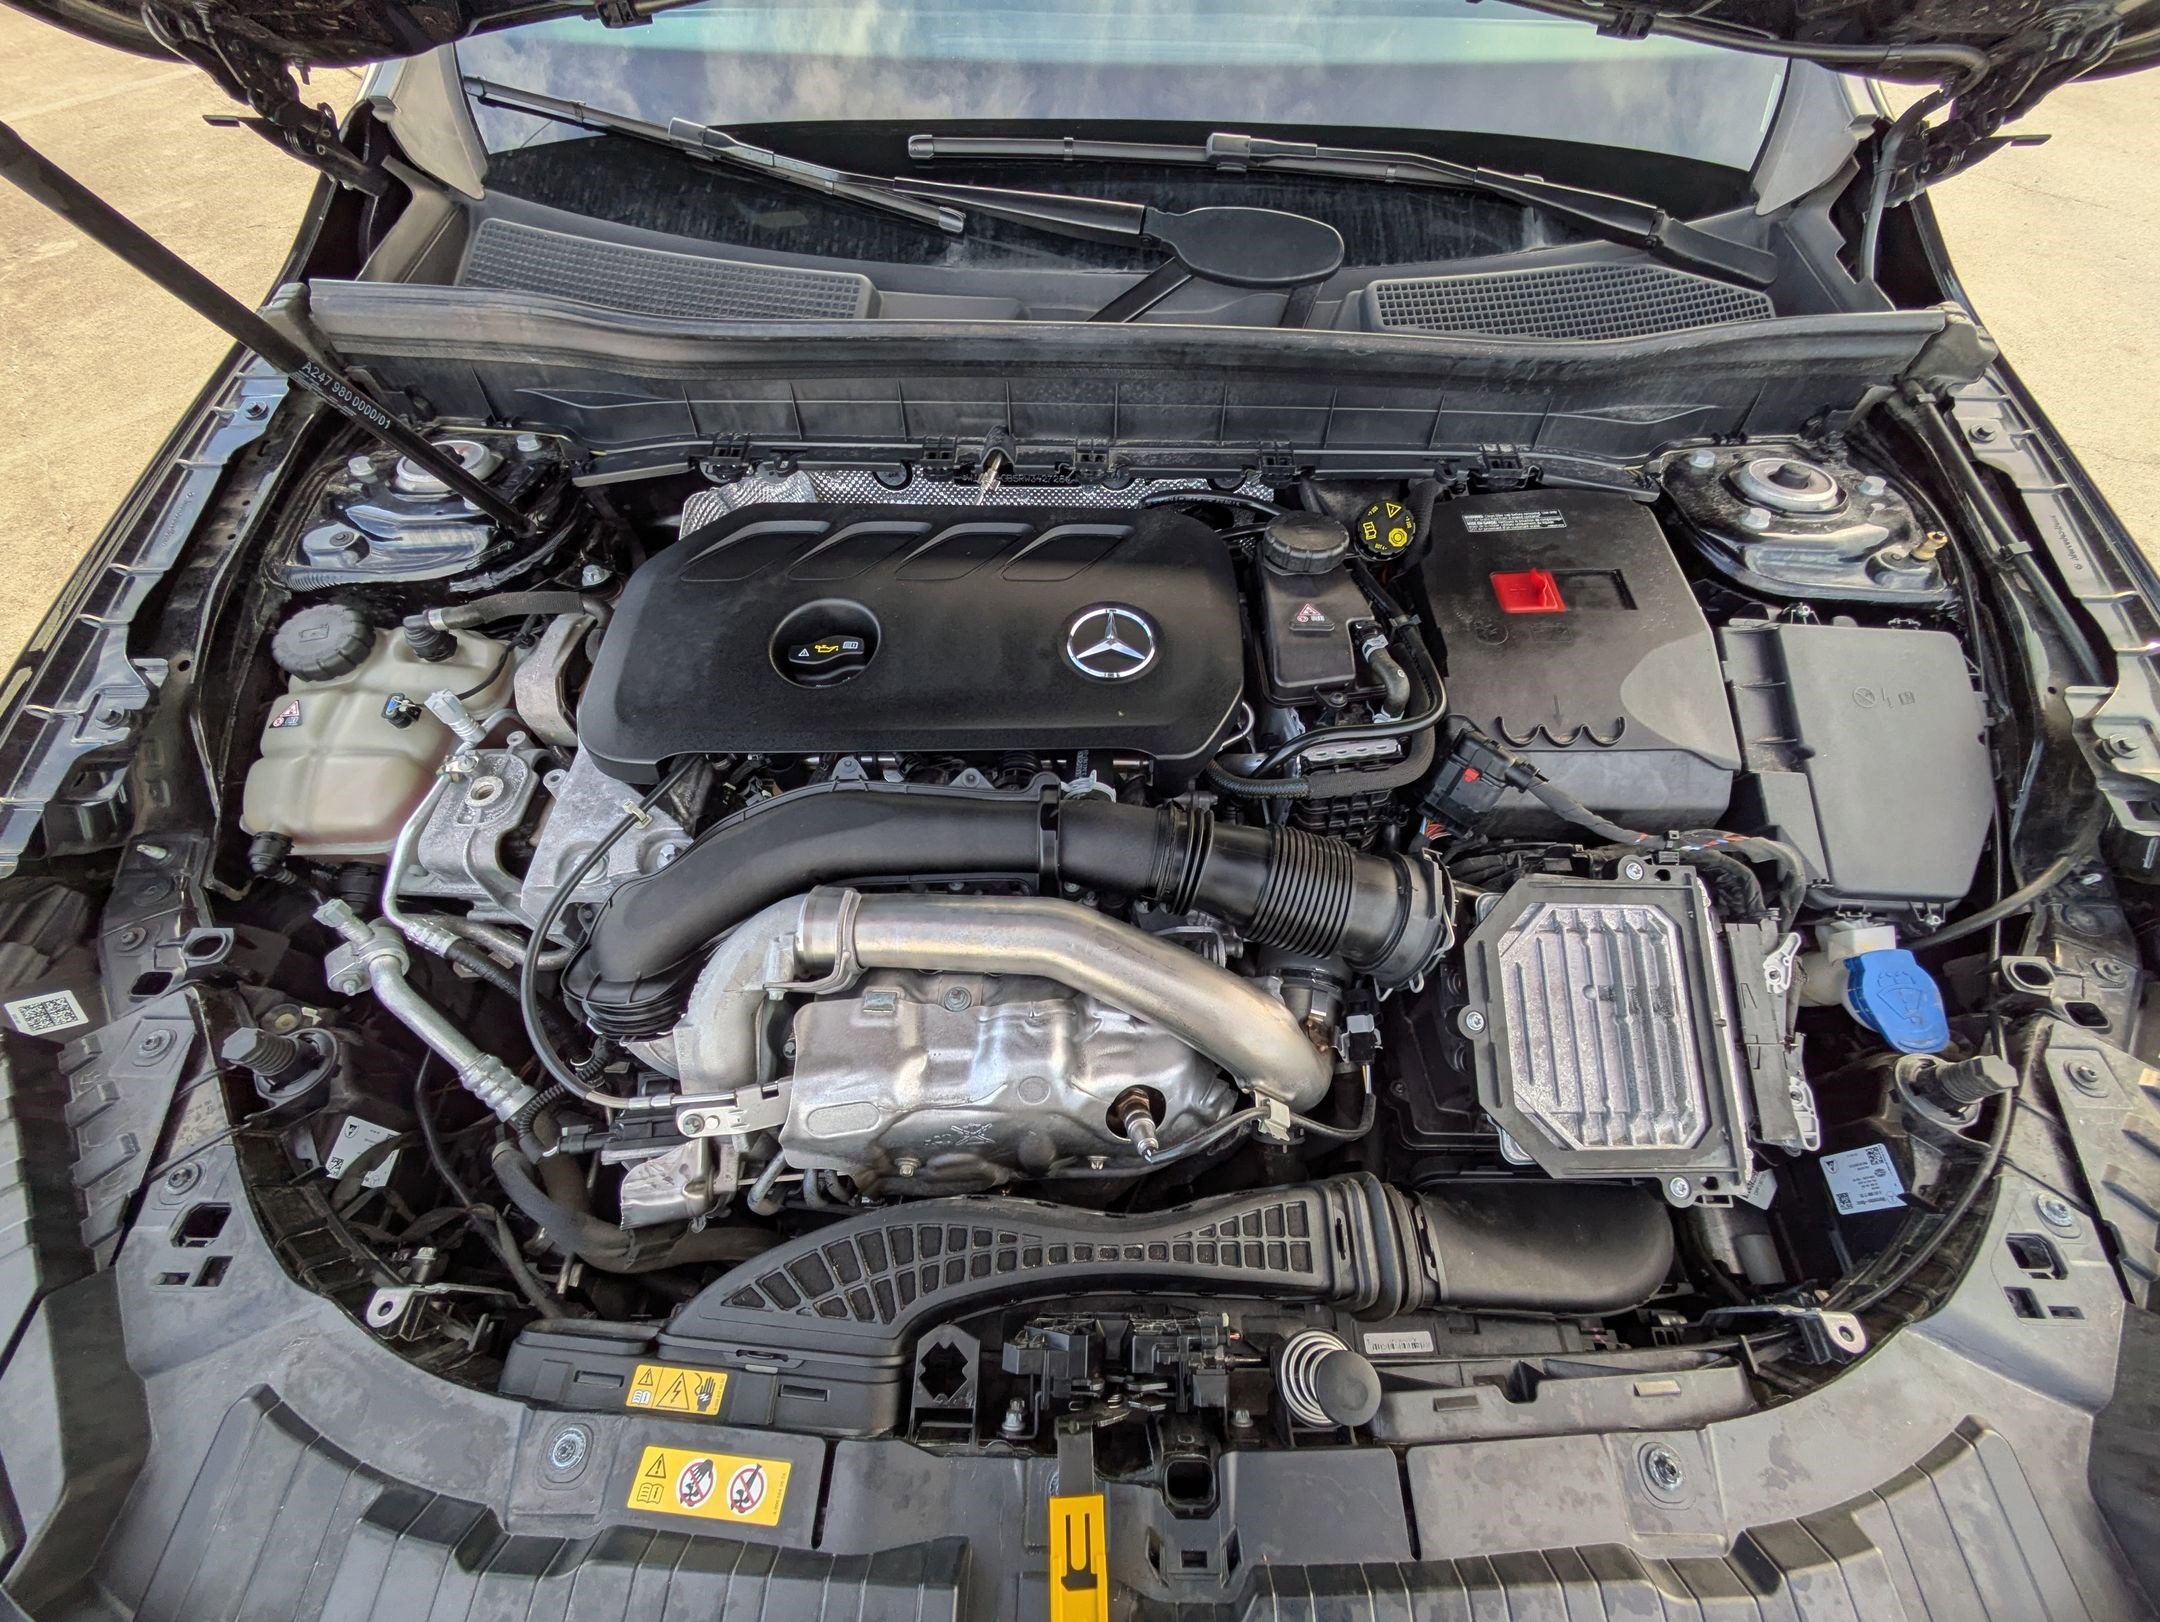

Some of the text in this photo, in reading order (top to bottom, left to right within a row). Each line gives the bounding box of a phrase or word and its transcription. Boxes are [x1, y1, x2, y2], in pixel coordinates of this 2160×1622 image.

[302, 361, 333, 386] A247
[331, 381, 353, 401] 980
[352, 397, 390, 429] 0000/01
